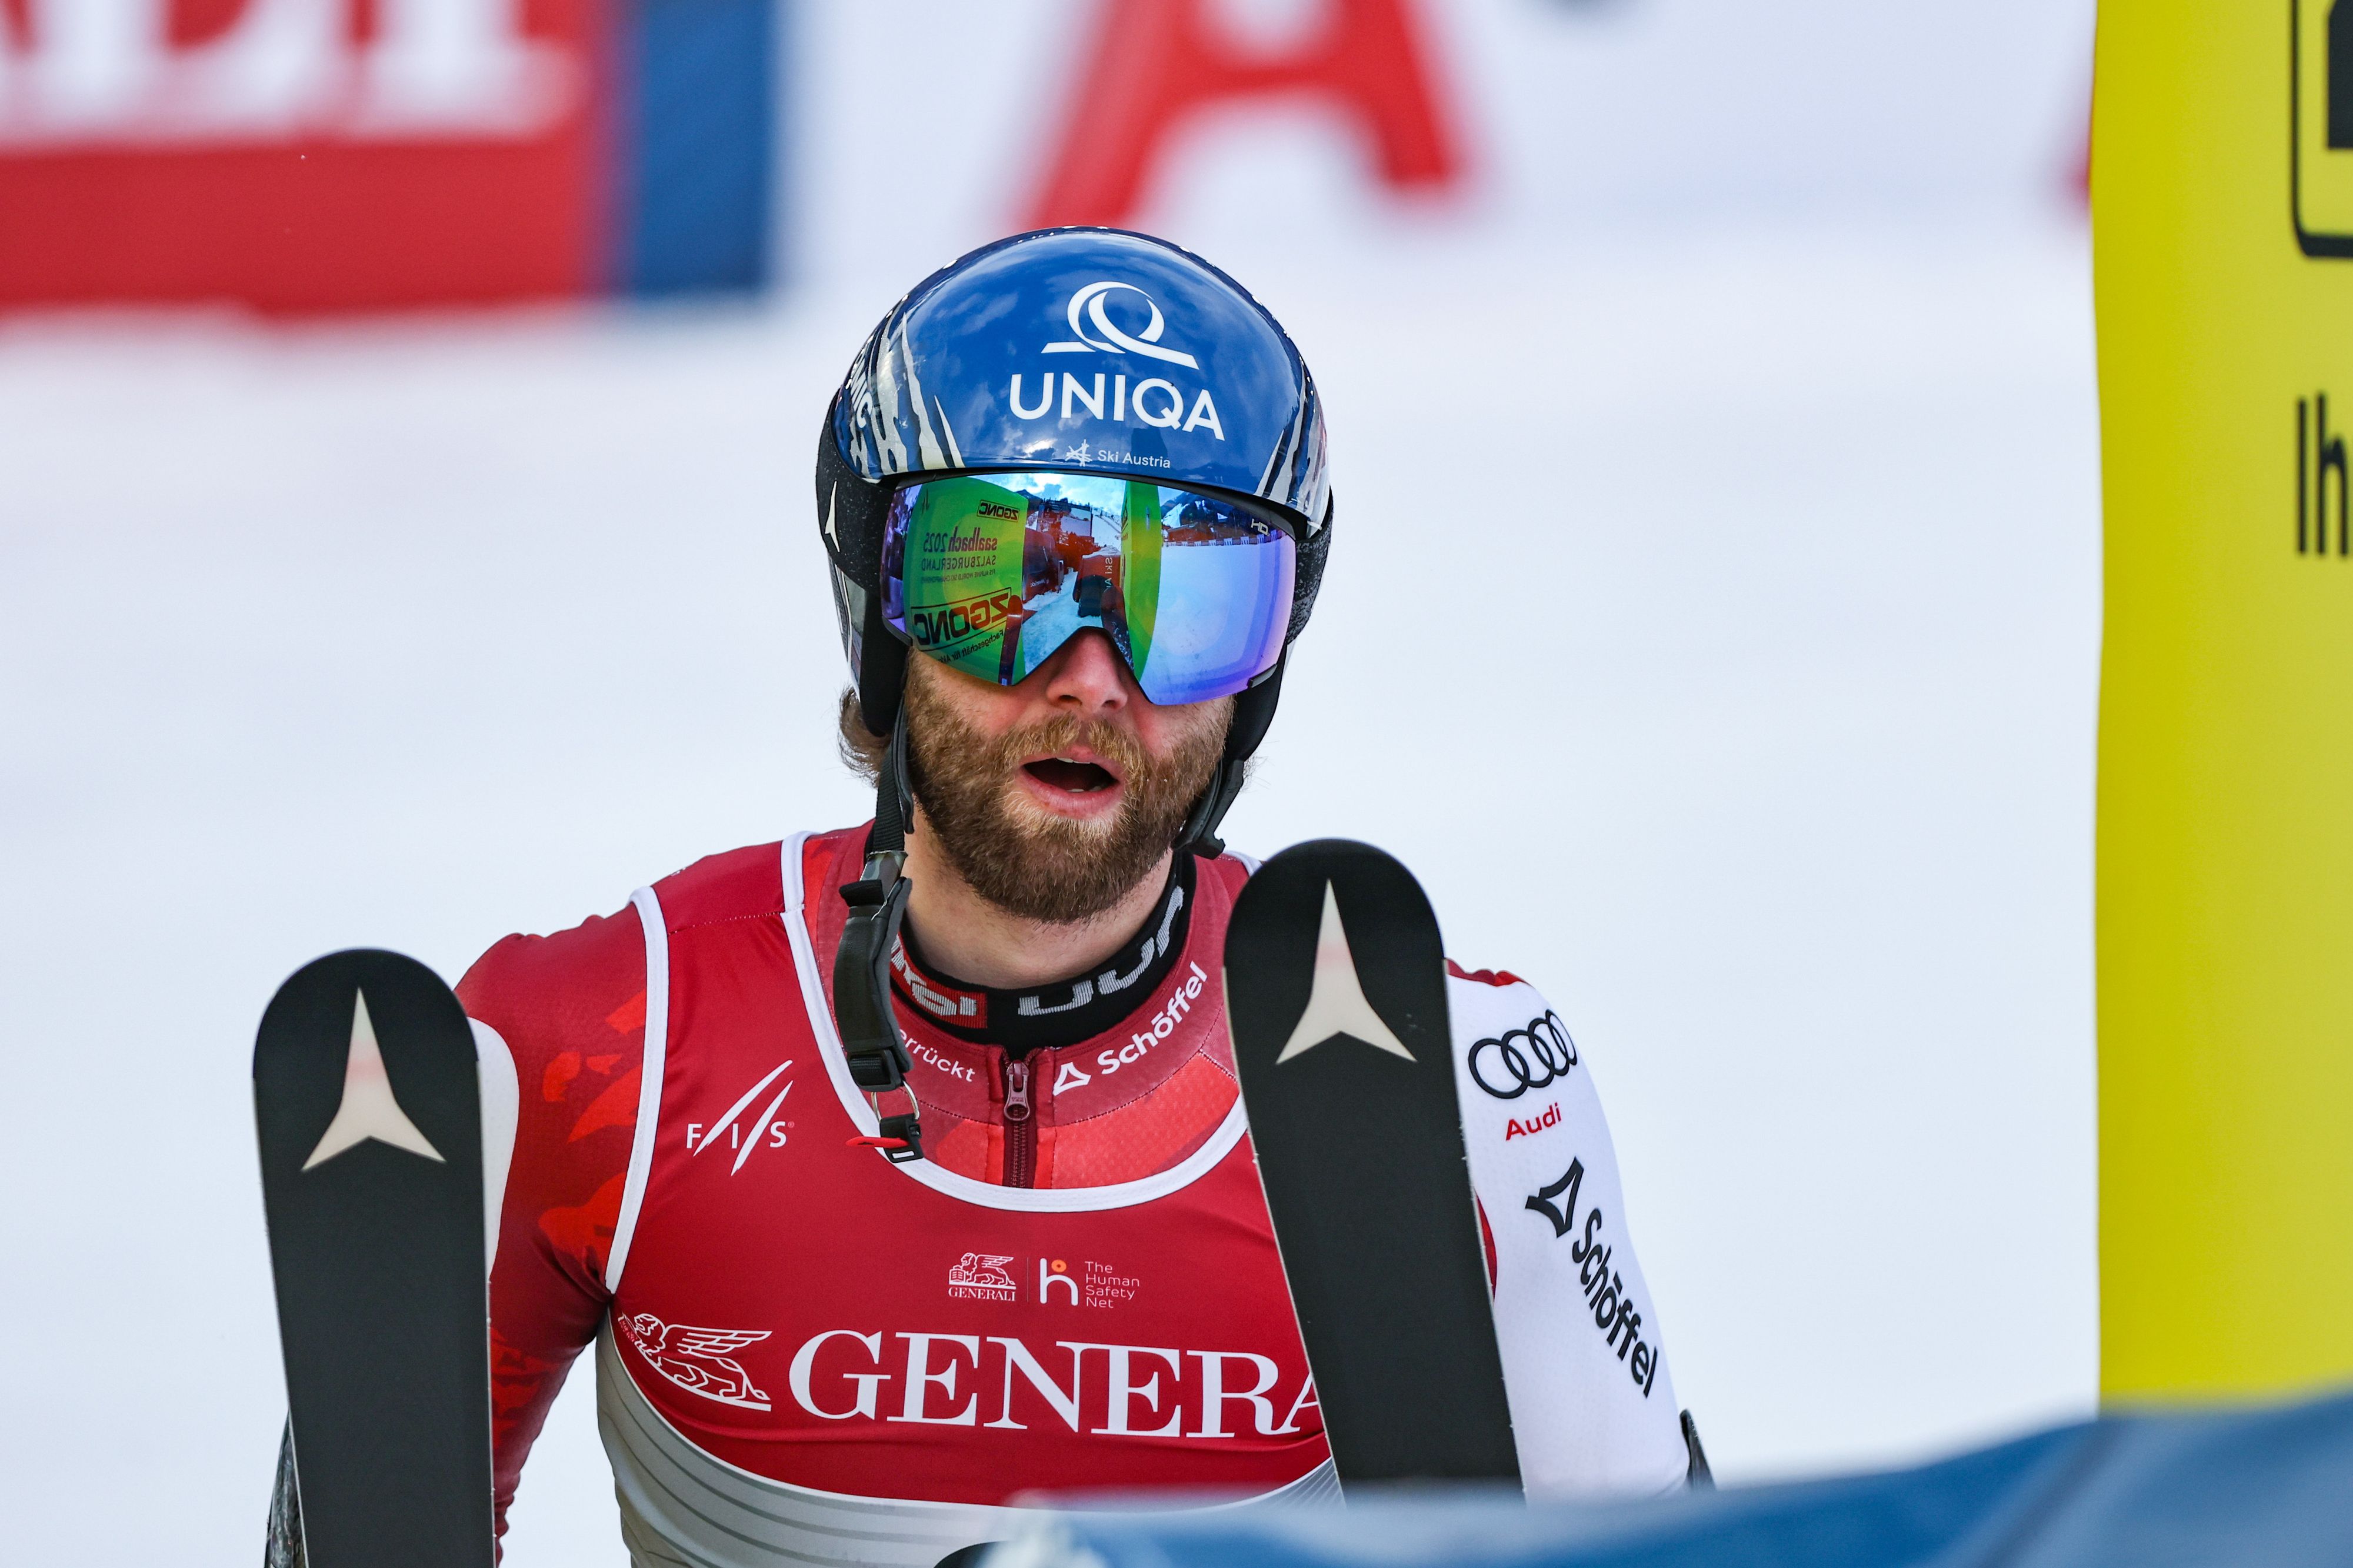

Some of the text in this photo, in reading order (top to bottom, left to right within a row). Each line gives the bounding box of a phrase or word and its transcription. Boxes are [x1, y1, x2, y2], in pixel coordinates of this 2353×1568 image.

[1010, 372, 1225, 441] UNIQA
[1098, 450, 1171, 469] Ski Austria
[1505, 1102, 1562, 1141] Audi
[1084, 1260, 1113, 1273] The
[1086, 1273, 1140, 1287] Human
[948, 1287, 1016, 1302] GENERALI
[1086, 1285, 1135, 1299] Safety
[1086, 1297, 1114, 1309] Net
